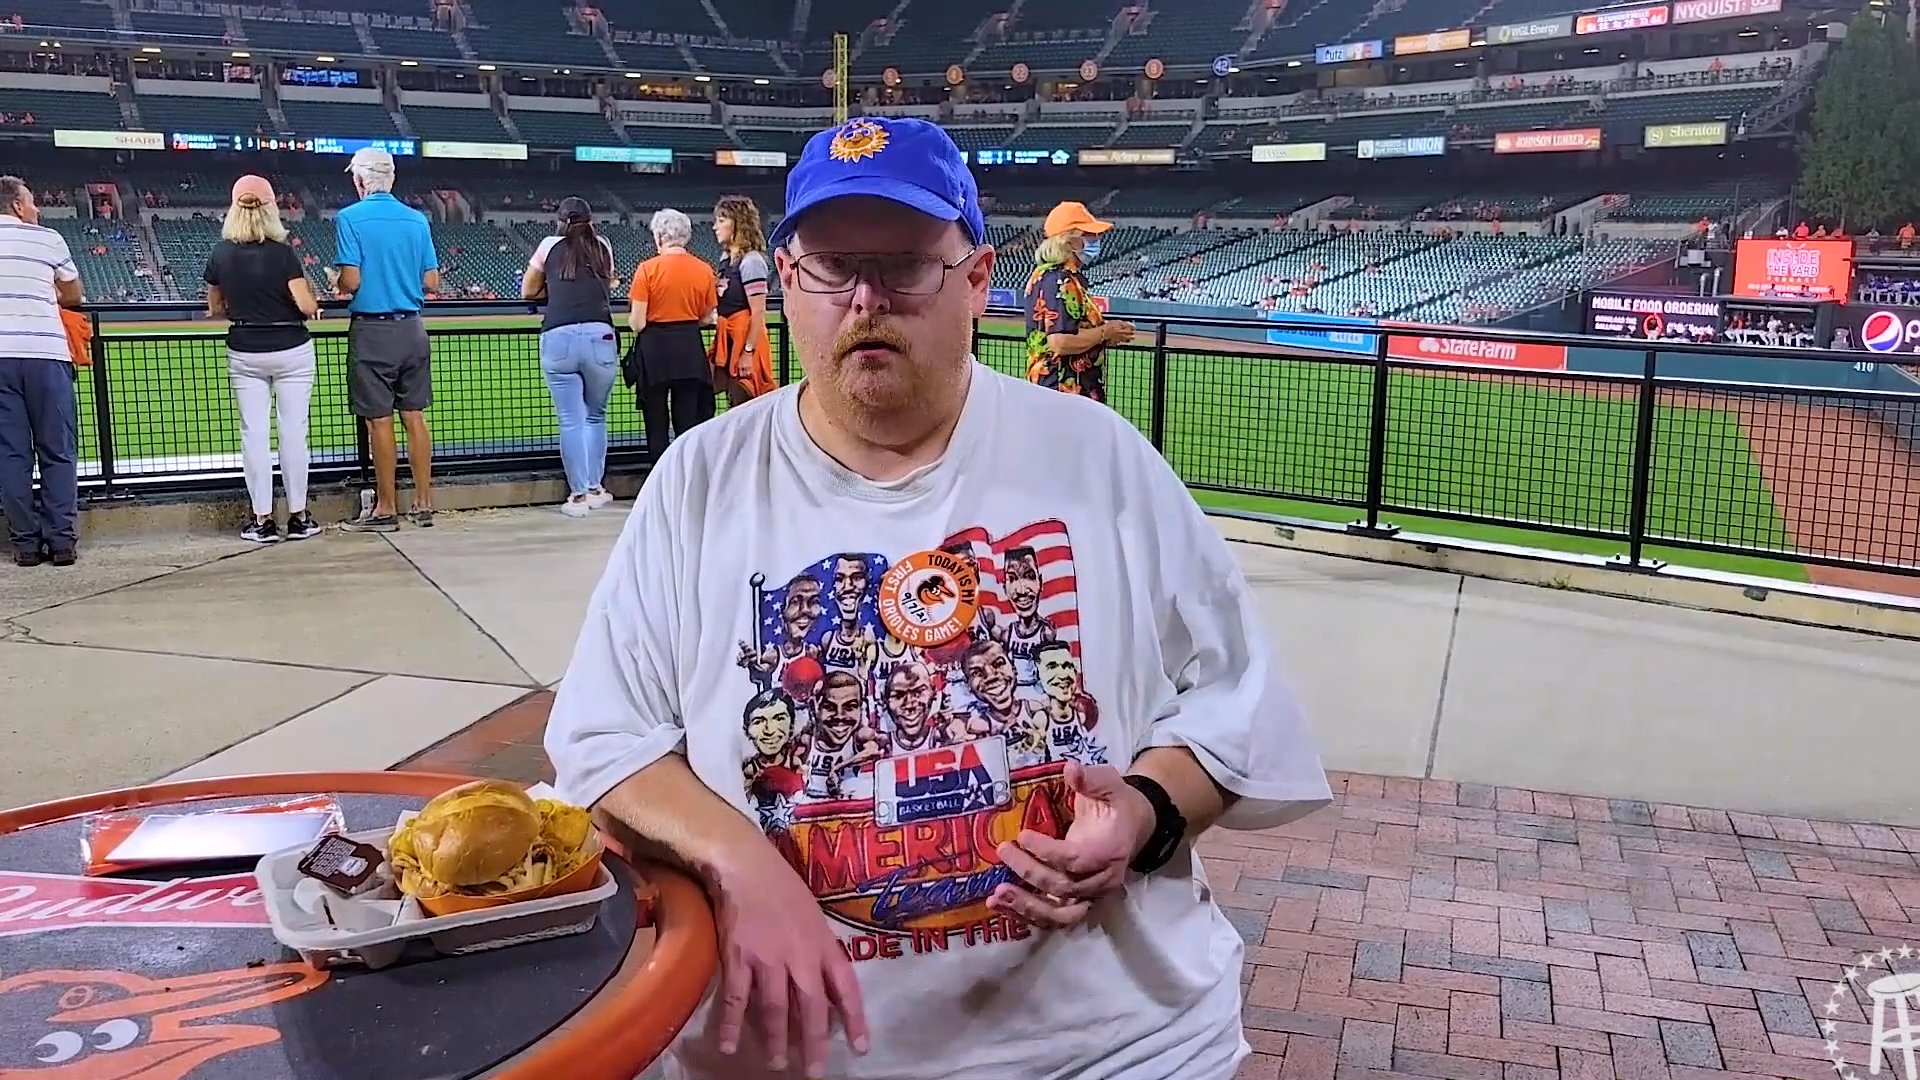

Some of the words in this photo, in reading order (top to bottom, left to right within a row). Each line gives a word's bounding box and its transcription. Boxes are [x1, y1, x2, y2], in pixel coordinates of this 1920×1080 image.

[1530, 24, 1560, 36] Energy
[1214, 60, 1229, 72] 42
[1670, 124, 1721, 137] Sheraton
[115, 136, 161, 145] SHARP
[1407, 137, 1445, 153] UNION
[1516, 135, 1552, 148] JOHNSON
[1553, 134, 1585, 146] LUMBER
[1766, 249, 1820, 265] INSIDE
[1767, 265, 1788, 276] THE
[1790, 265, 1819, 277] YARD
[1592, 296, 1632, 311] MOBILE
[1632, 299, 1663, 313] FOOD
[1853, 361, 1874, 373] 410
[927, 554, 965, 576] TODAY
[884, 560, 914, 594] FIRST
[958, 574, 972, 587] IS
[961, 588, 975, 606] MY
[882, 598, 920, 641] ORIOLES
[924, 616, 963, 642] GAME!
[1052, 725, 1081, 740] USA
[894, 743, 995, 806] USA
[899, 798, 961, 816] BASKETBALL
[911, 926, 950, 954] IN
[964, 913, 1031, 947] THE
